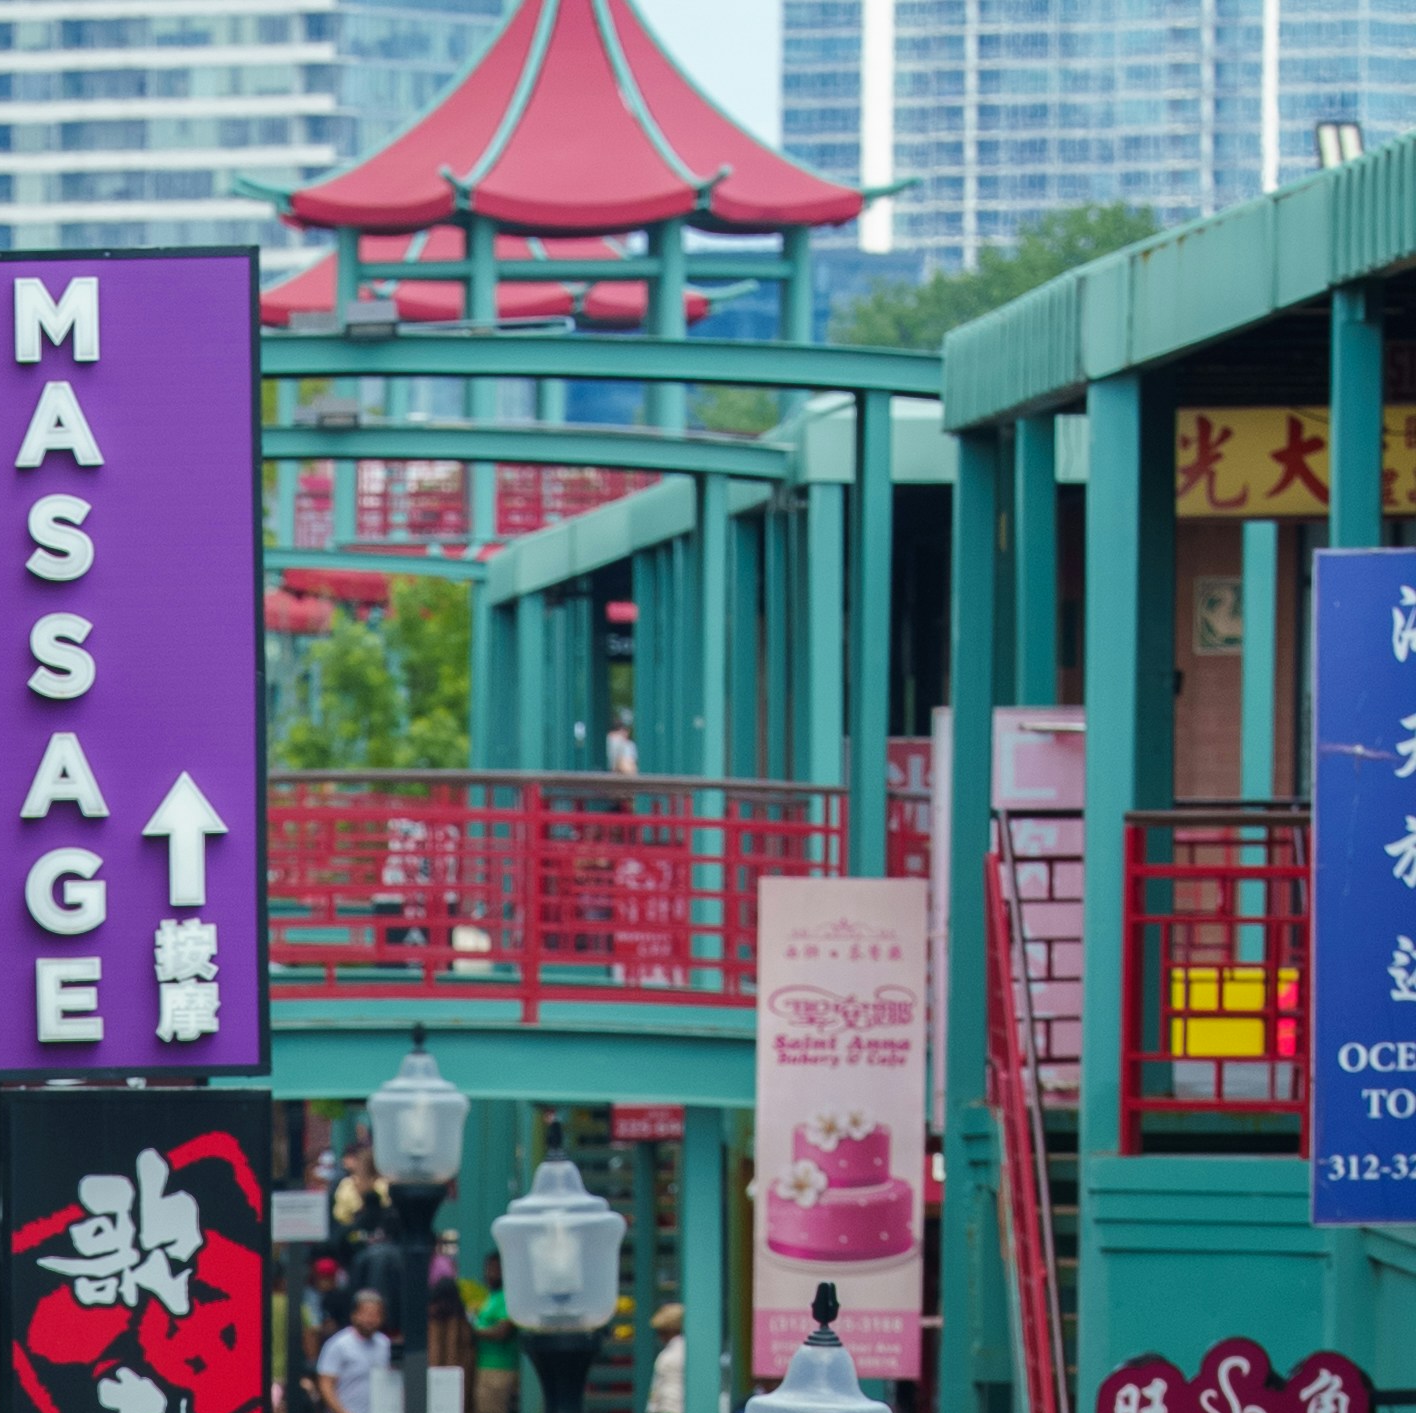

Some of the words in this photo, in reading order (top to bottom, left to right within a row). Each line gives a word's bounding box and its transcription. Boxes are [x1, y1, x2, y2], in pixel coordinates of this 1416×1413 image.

[12, 275, 112, 1043] MASSAGE
[155, 918, 220, 1043] 按摩
[775, 1034, 837, 1050] Saint
[848, 1035, 911, 1050] Anna
